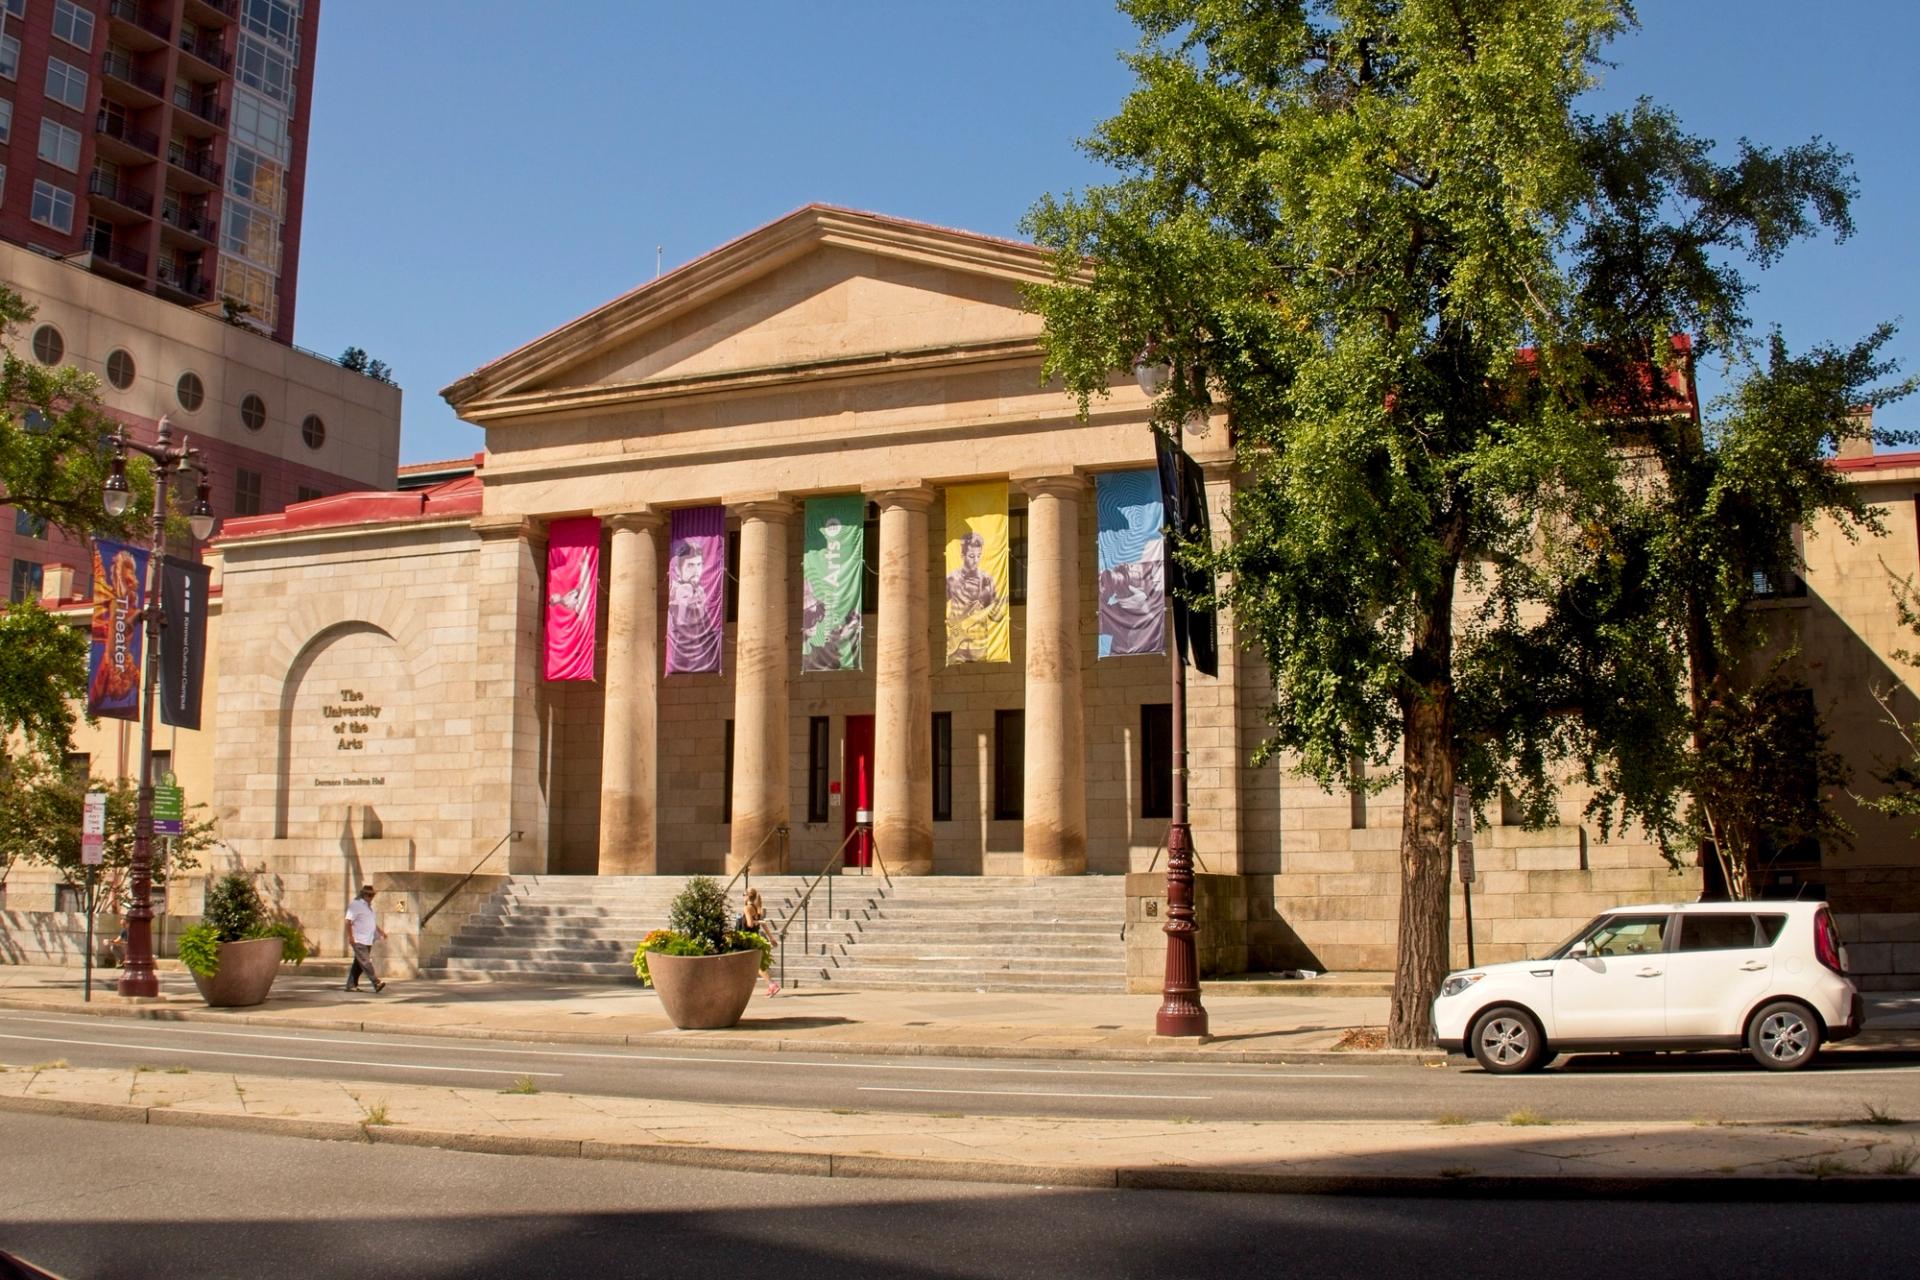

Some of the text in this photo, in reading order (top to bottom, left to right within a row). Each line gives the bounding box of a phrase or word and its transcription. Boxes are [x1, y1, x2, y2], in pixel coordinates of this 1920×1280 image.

[824, 541, 841, 586] Arts
[115, 595, 129, 672] Theater
[341, 689, 364, 702] The
[323, 705, 381, 718] University
[333, 721, 369, 734] of the
[337, 738, 363, 750] Arts
